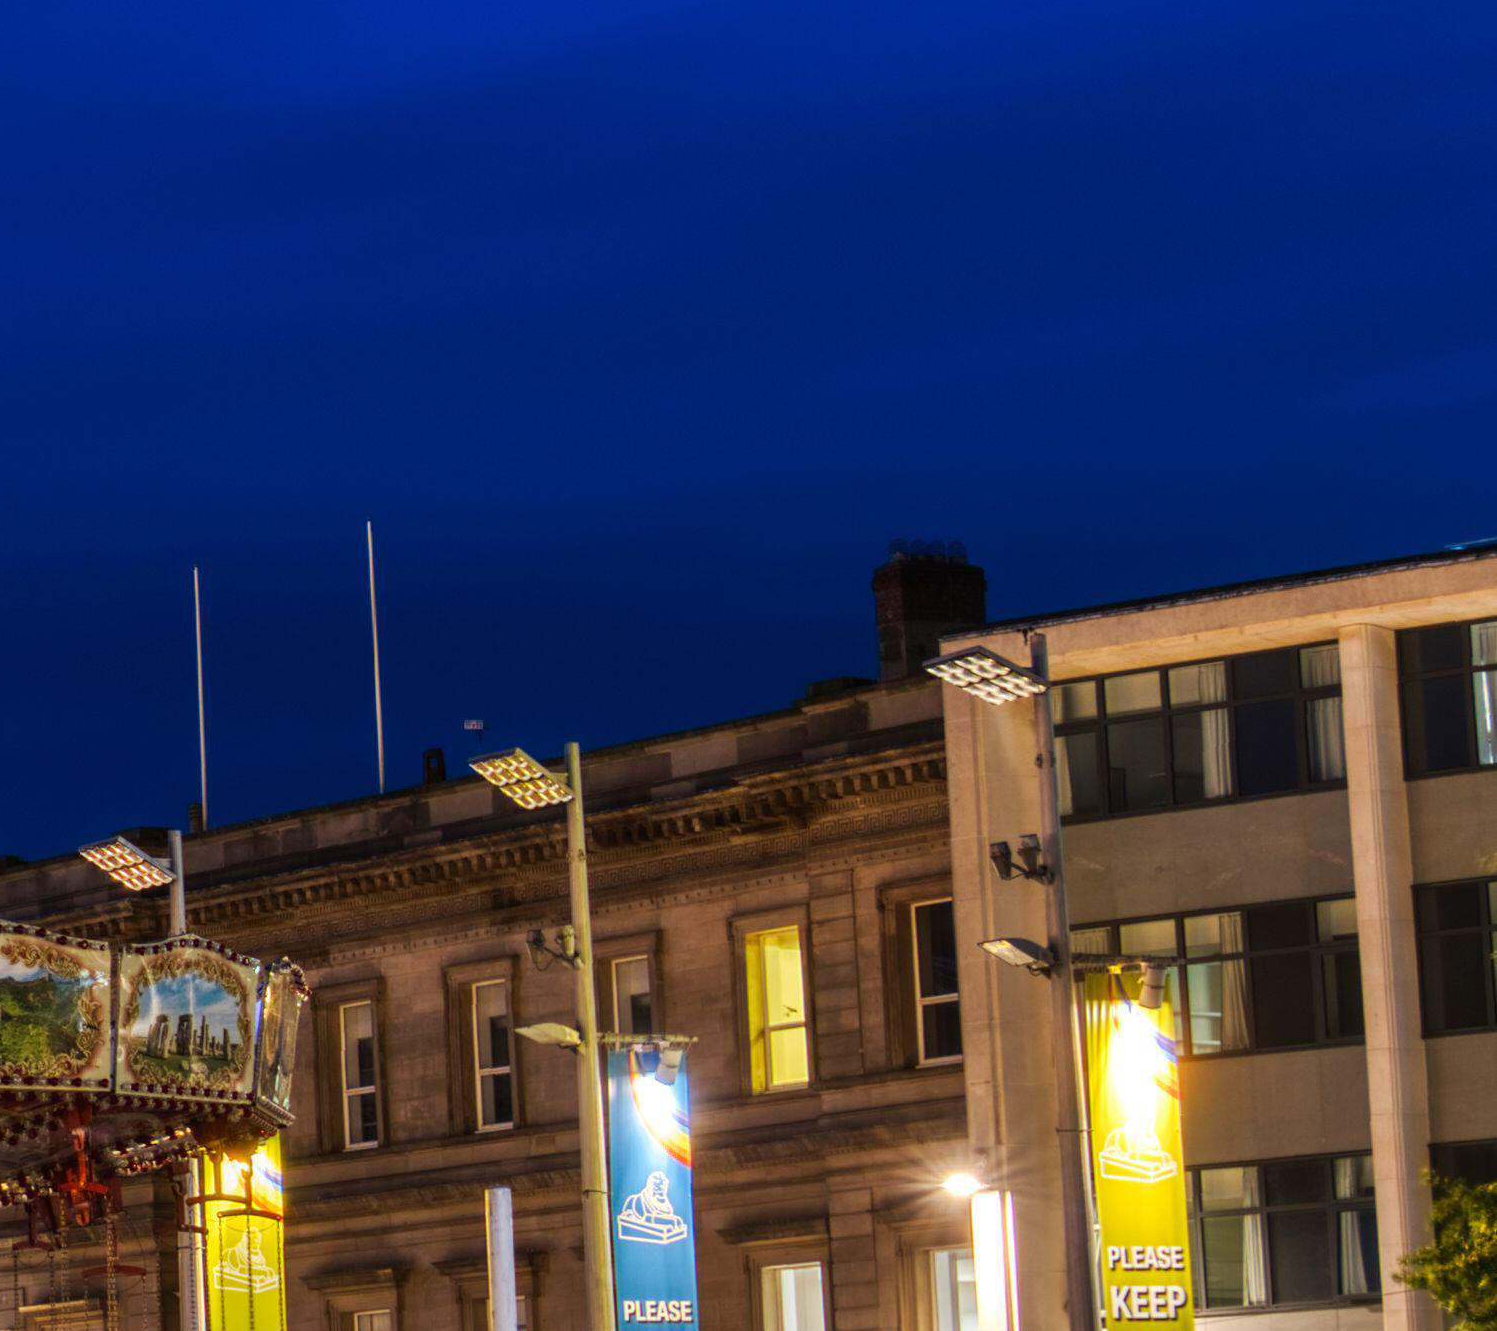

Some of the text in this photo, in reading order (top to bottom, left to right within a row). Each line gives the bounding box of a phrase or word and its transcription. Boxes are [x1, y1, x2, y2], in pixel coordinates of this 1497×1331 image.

[1107, 1245, 1185, 1270] PLEASE
[623, 1299, 694, 1323] PLEASE
[1110, 1285, 1188, 1321] KEEP
